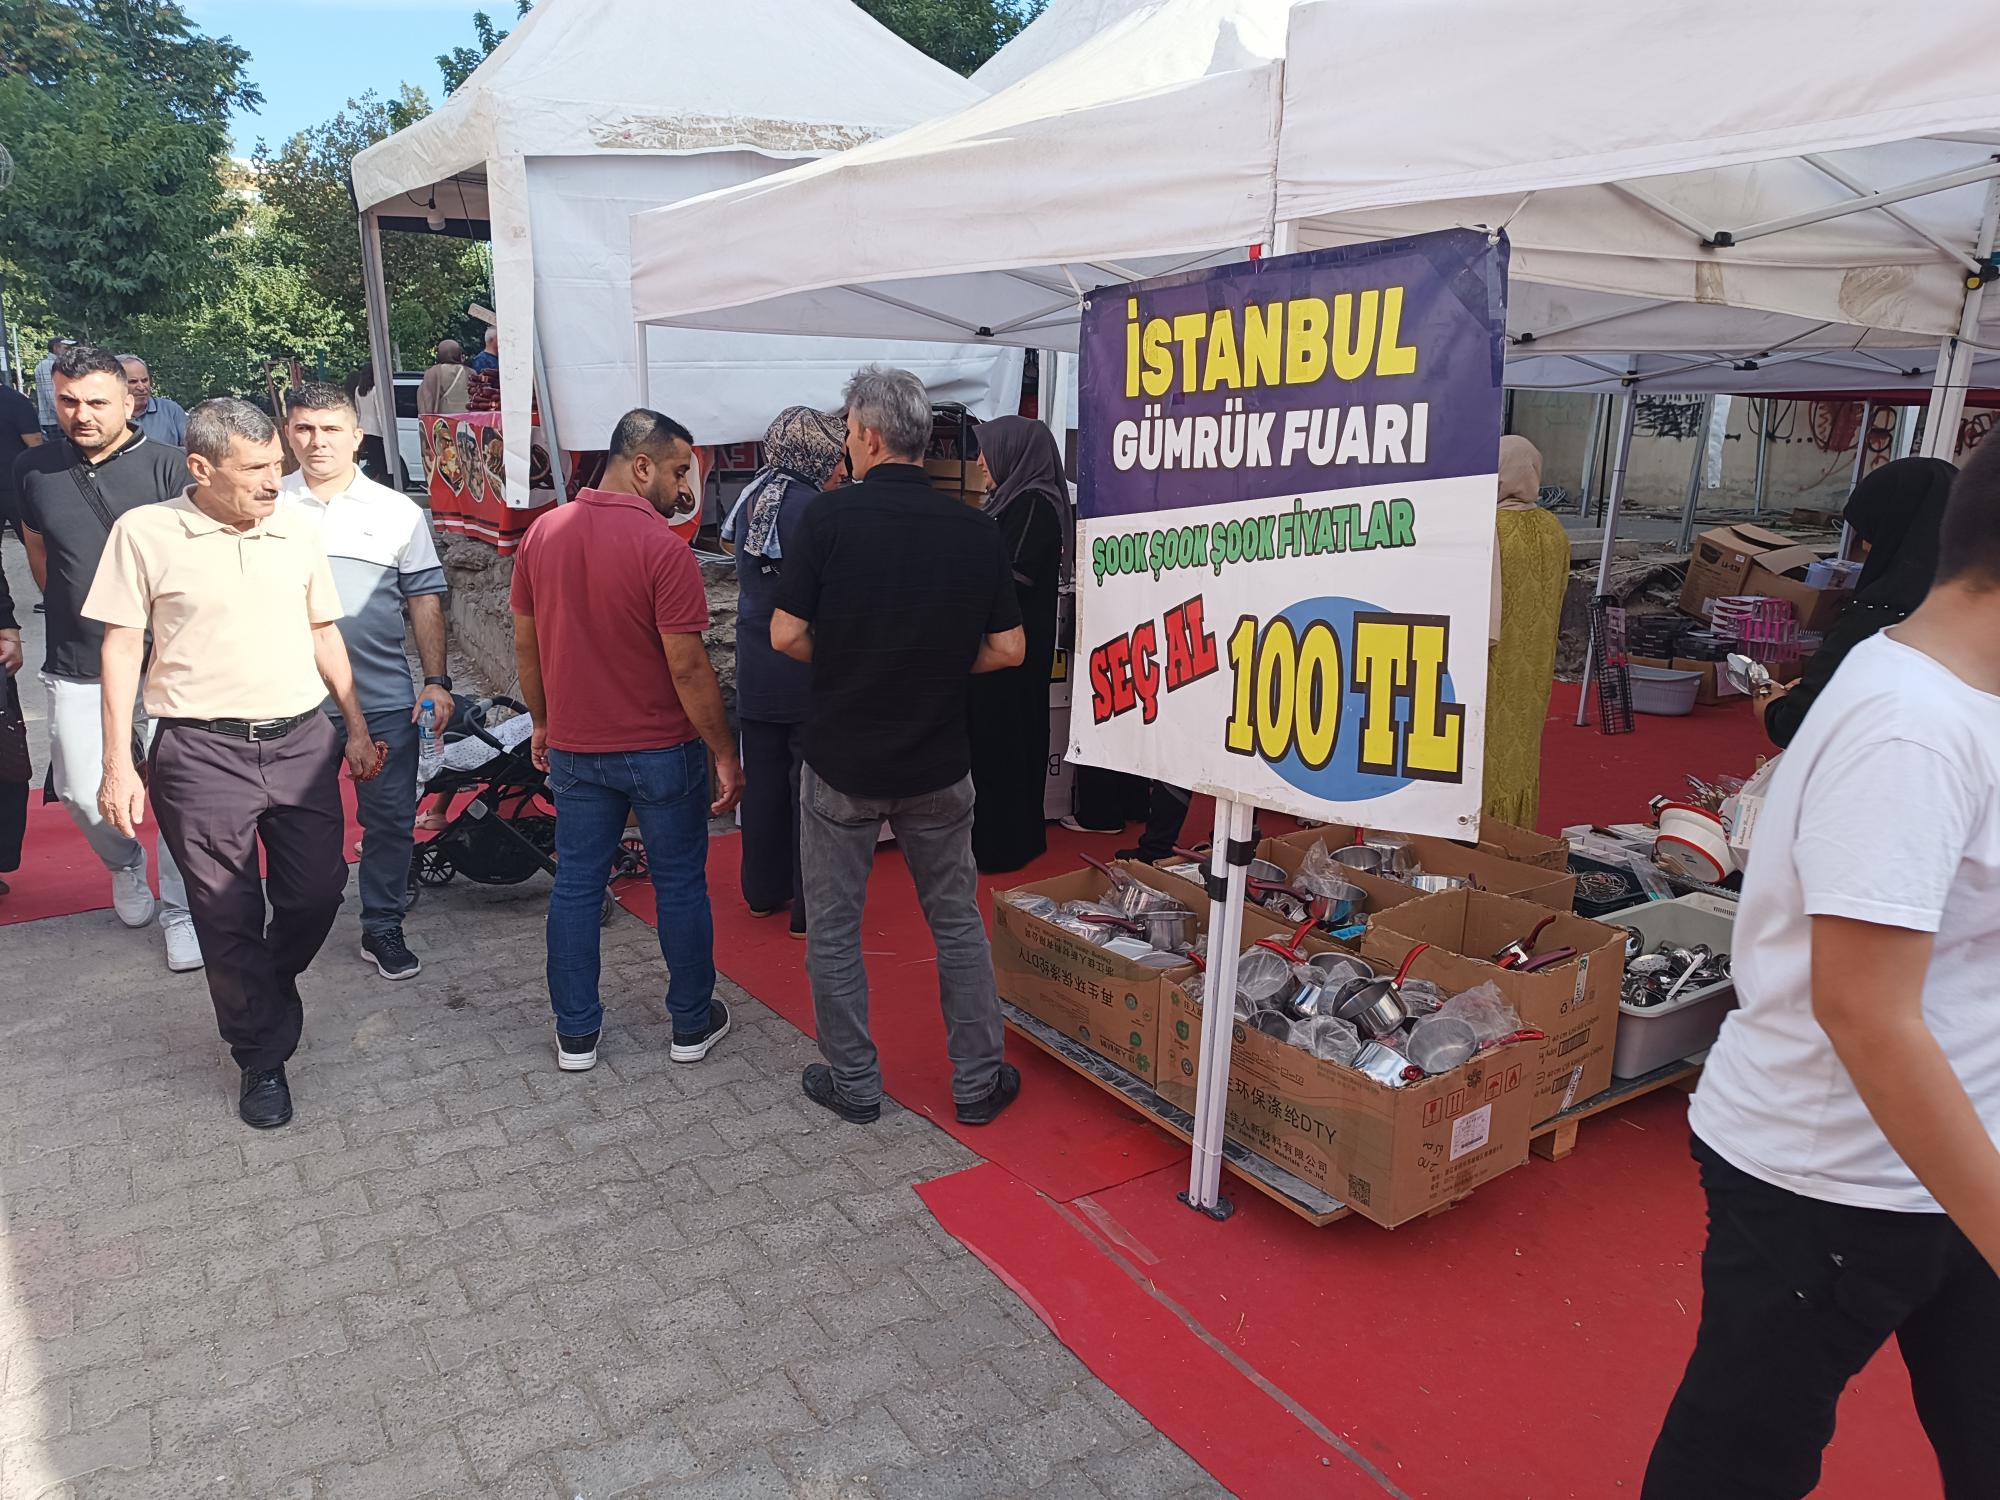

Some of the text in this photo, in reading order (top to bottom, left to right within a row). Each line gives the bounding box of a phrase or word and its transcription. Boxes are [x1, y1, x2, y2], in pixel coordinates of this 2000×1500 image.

[1126, 287, 1417, 397] İSTANBUL
[1113, 398, 1429, 471] GÜMRÜK FUARI
[1093, 498, 1416, 587] ŞOOK ŞOOK ŞOOK FİYATLAR
[1090, 593, 1219, 726] SEÇ AL
[1225, 611, 1466, 784] 100 TL
[1018, 947, 1114, 1008] 再生环保涤纶DTY
